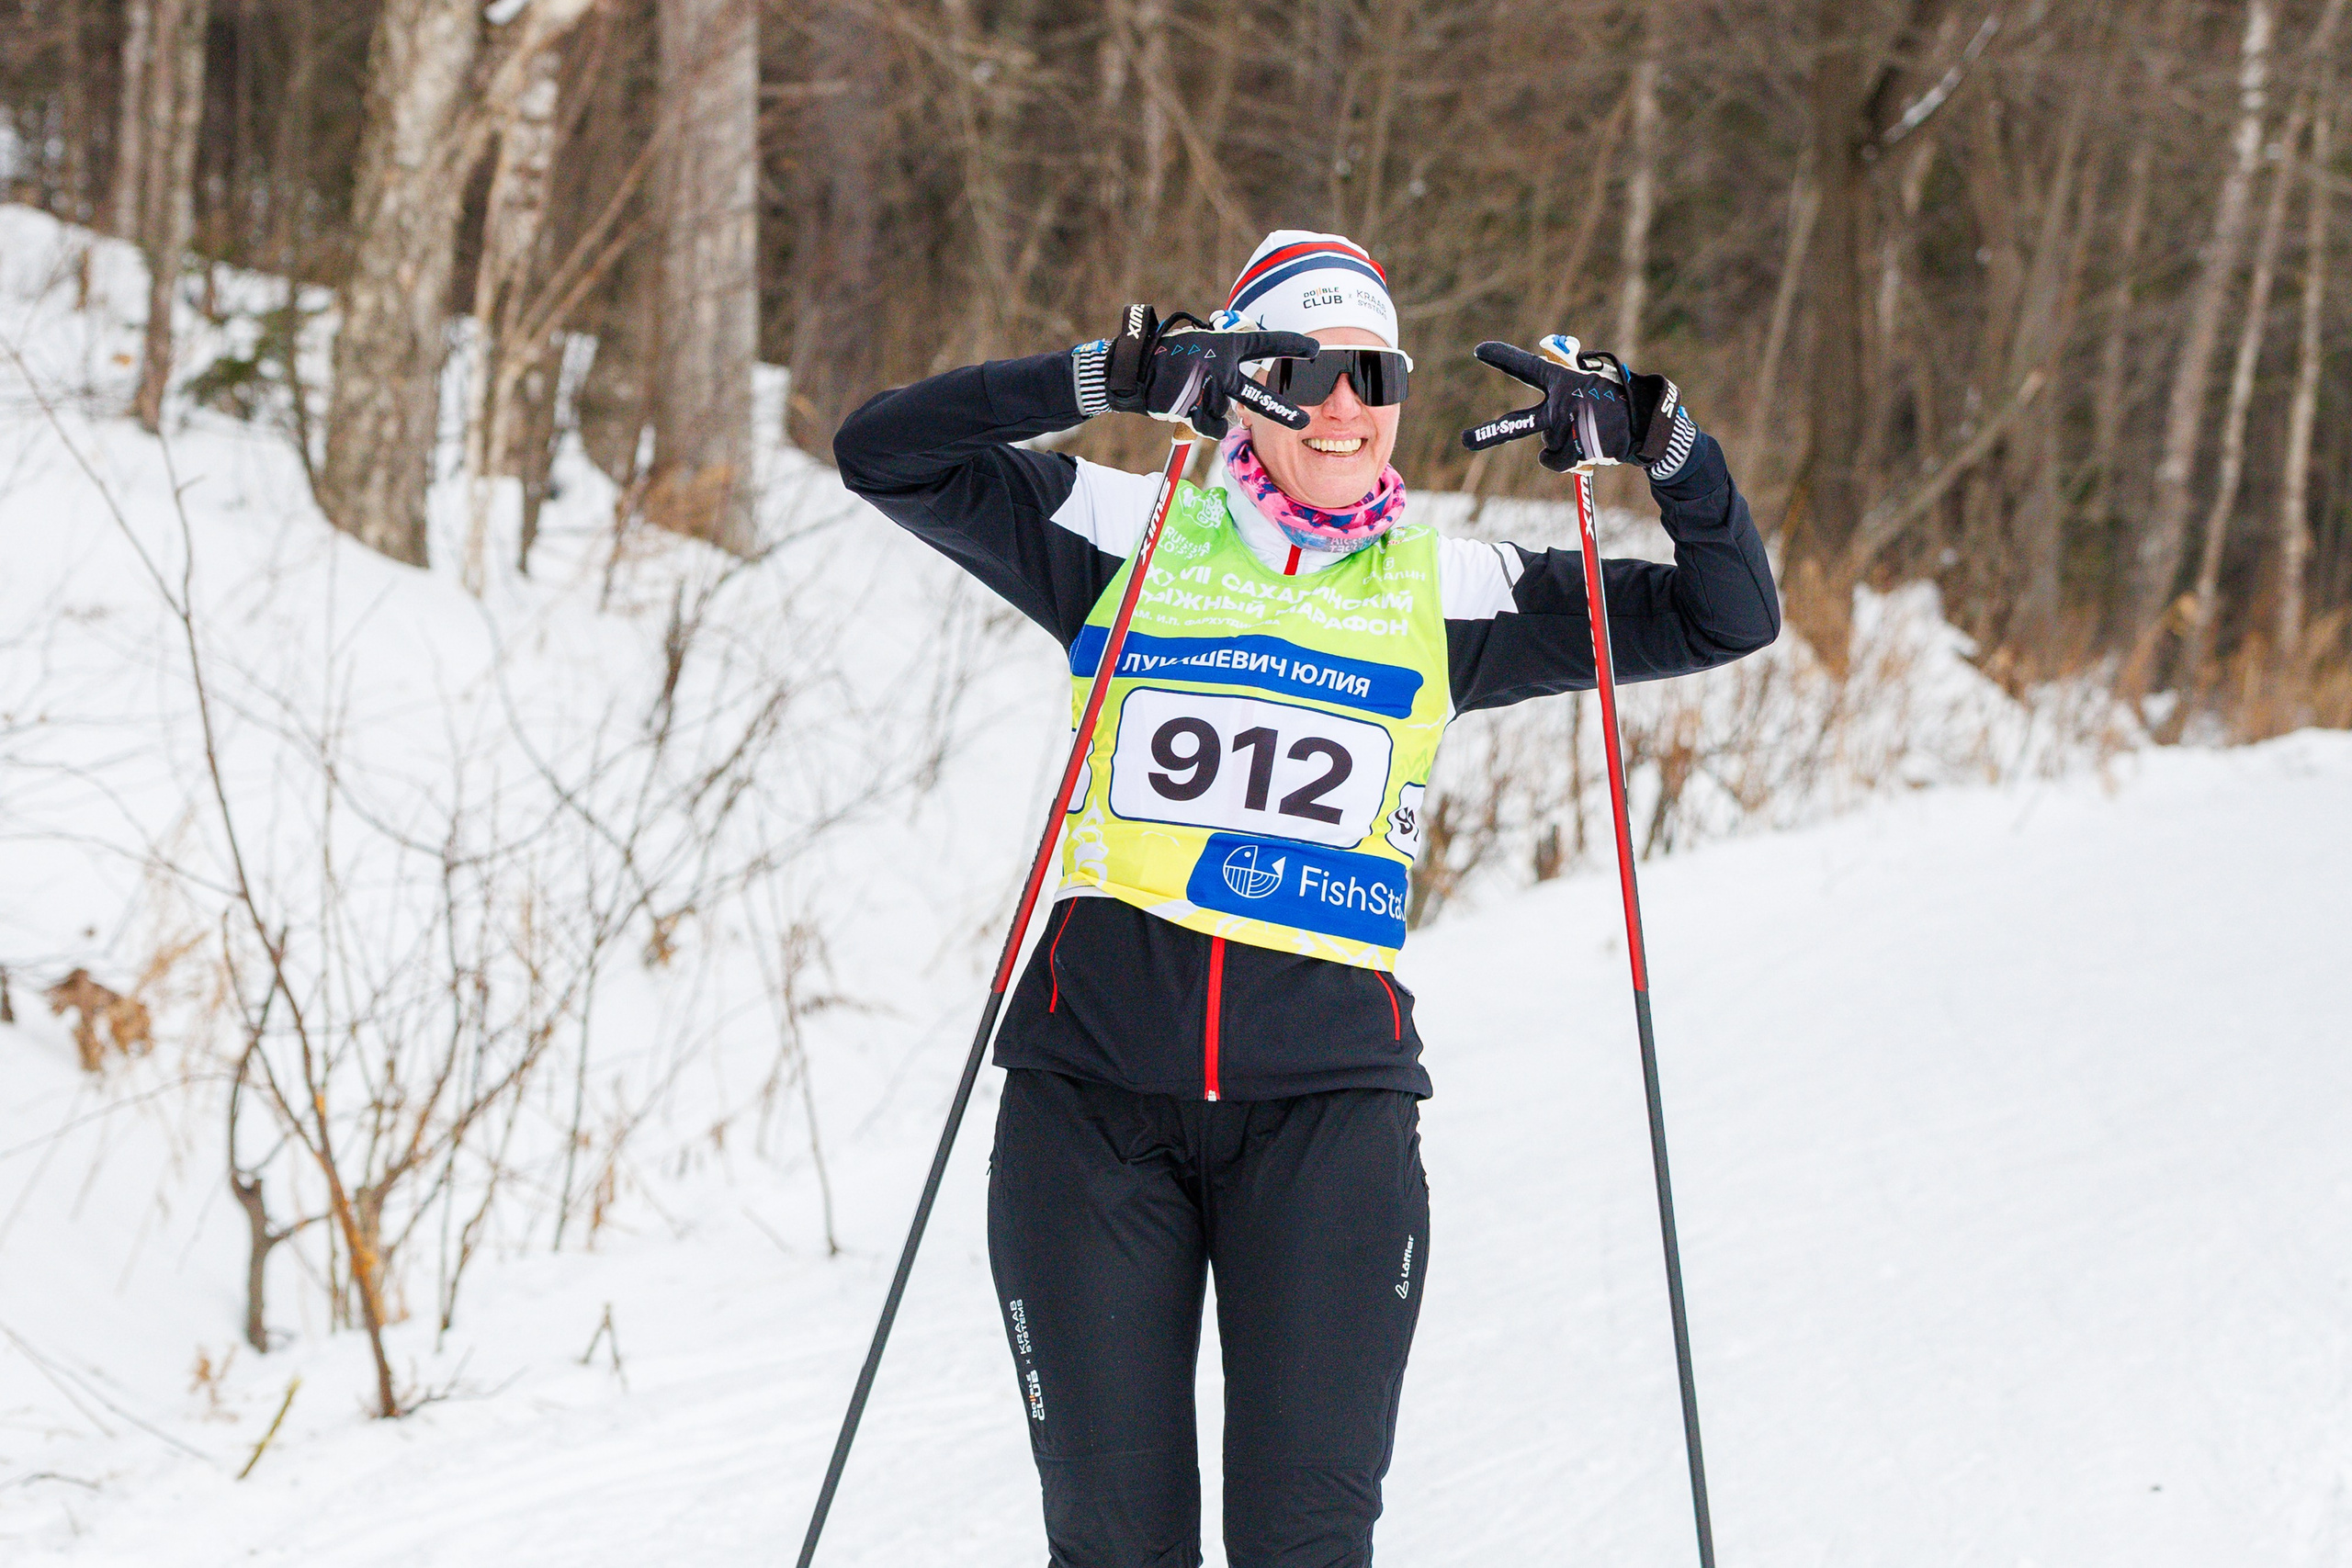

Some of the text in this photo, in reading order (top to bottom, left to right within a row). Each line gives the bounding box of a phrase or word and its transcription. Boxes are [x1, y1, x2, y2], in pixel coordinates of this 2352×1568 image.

[1303, 295, 1343, 309] CLUB
[1183, 616, 1281, 629] ФАРХУТДИВА
[1290, 660, 1372, 698] ЮЛИЯ
[1148, 716, 1353, 825] 912
[1299, 864, 1406, 922] FishSta
[1010, 1300, 1027, 1355] KRAAB
[1016, 1299, 1032, 1353] SYSTEMS
[1030, 1370, 1046, 1421] CLUB
